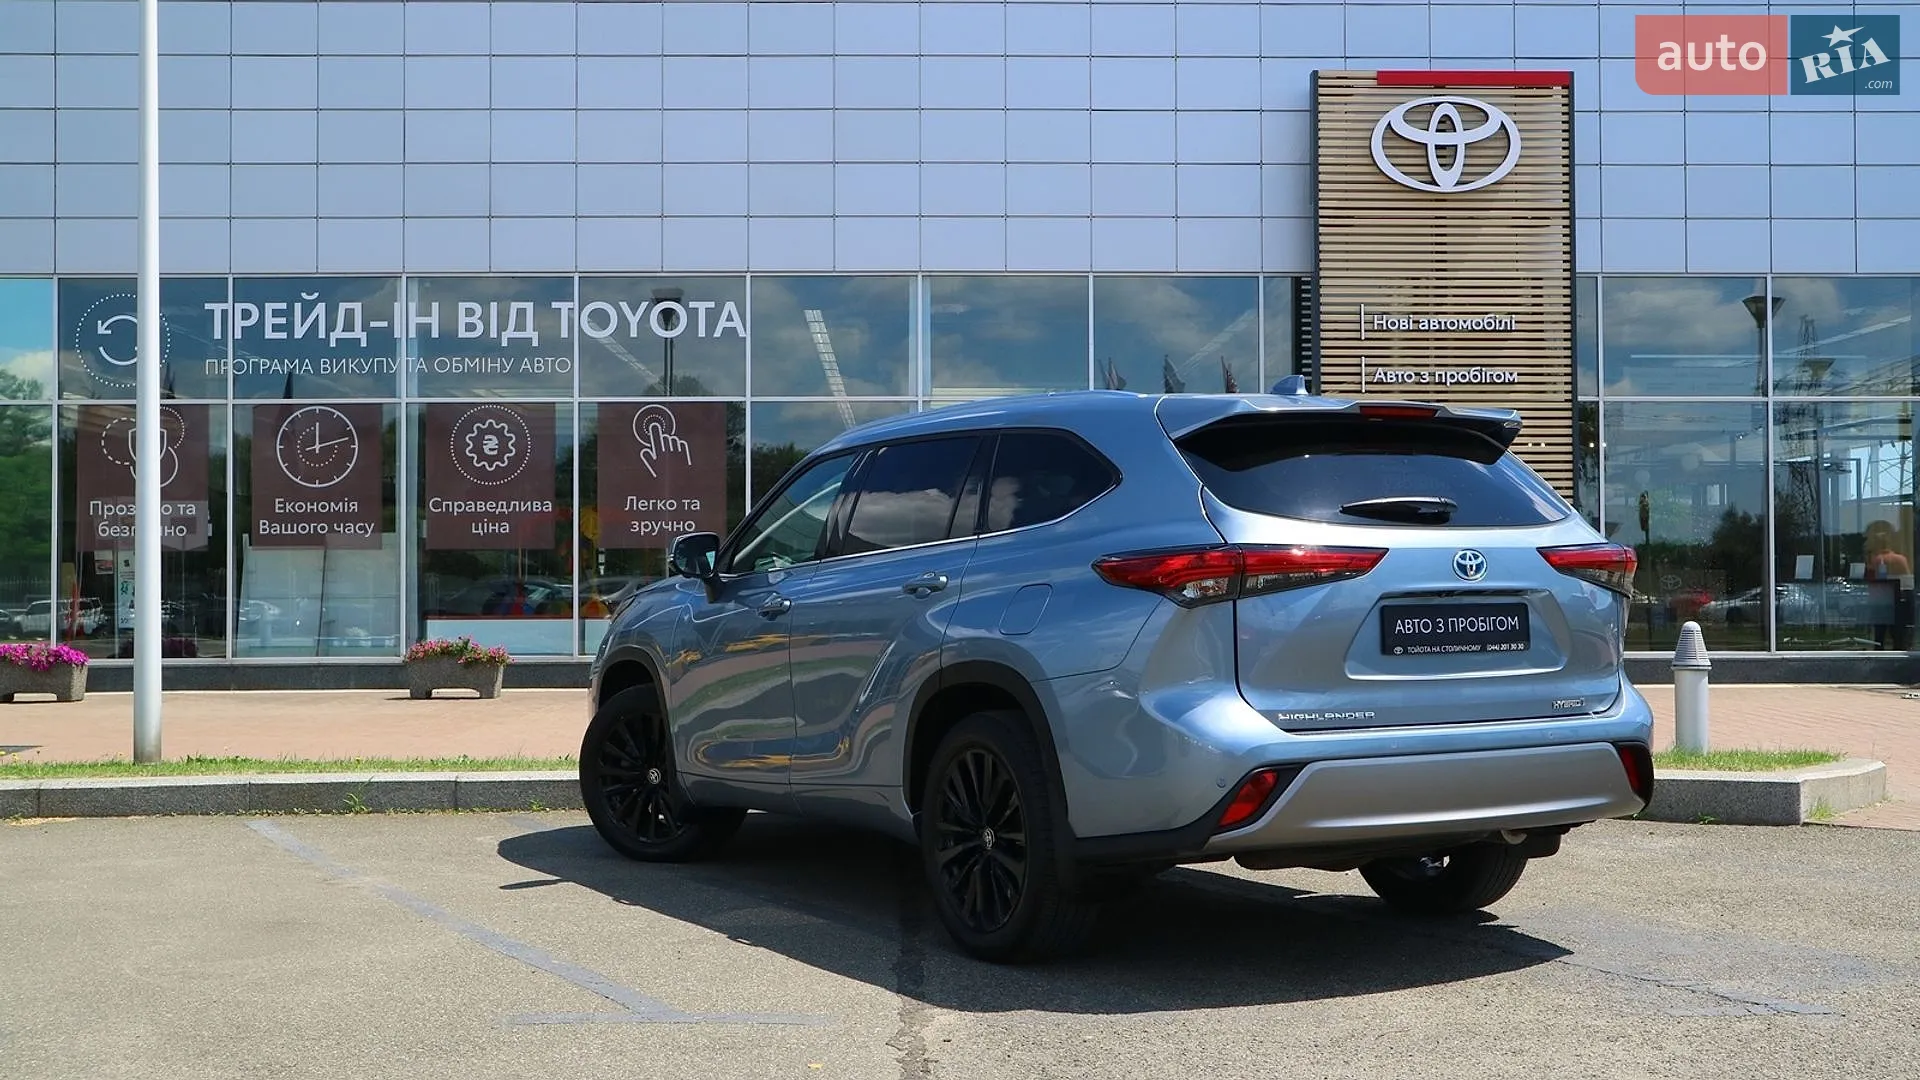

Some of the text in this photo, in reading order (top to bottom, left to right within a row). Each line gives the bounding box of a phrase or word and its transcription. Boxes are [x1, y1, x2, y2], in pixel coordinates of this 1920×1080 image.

[204, 292, 746, 347] ТРЕЙД-ІН ВІД TOYOTA
[1373, 315, 1516, 331] Нові автомобілі
[205, 357, 571, 375] ПРОГРАМА ВИКУПУ ТА ОБМІНУ АВТО
[1373, 368, 1416, 383] Авто
[1435, 367, 1518, 387] пробігом
[90, 501, 196, 519] Прозо та
[274, 498, 358, 513] Економія
[429, 497, 552, 516] Справедлива
[624, 496, 700, 511] Легко та
[259, 520, 375, 537] Вашого часу
[471, 518, 510, 536] ціна
[630, 521, 696, 536] зручно
[1395, 618, 1432, 634] АВТО
[1448, 616, 1519, 633] ПРОБІГОМ
[1278, 711, 1375, 721] HIGHLANDER
